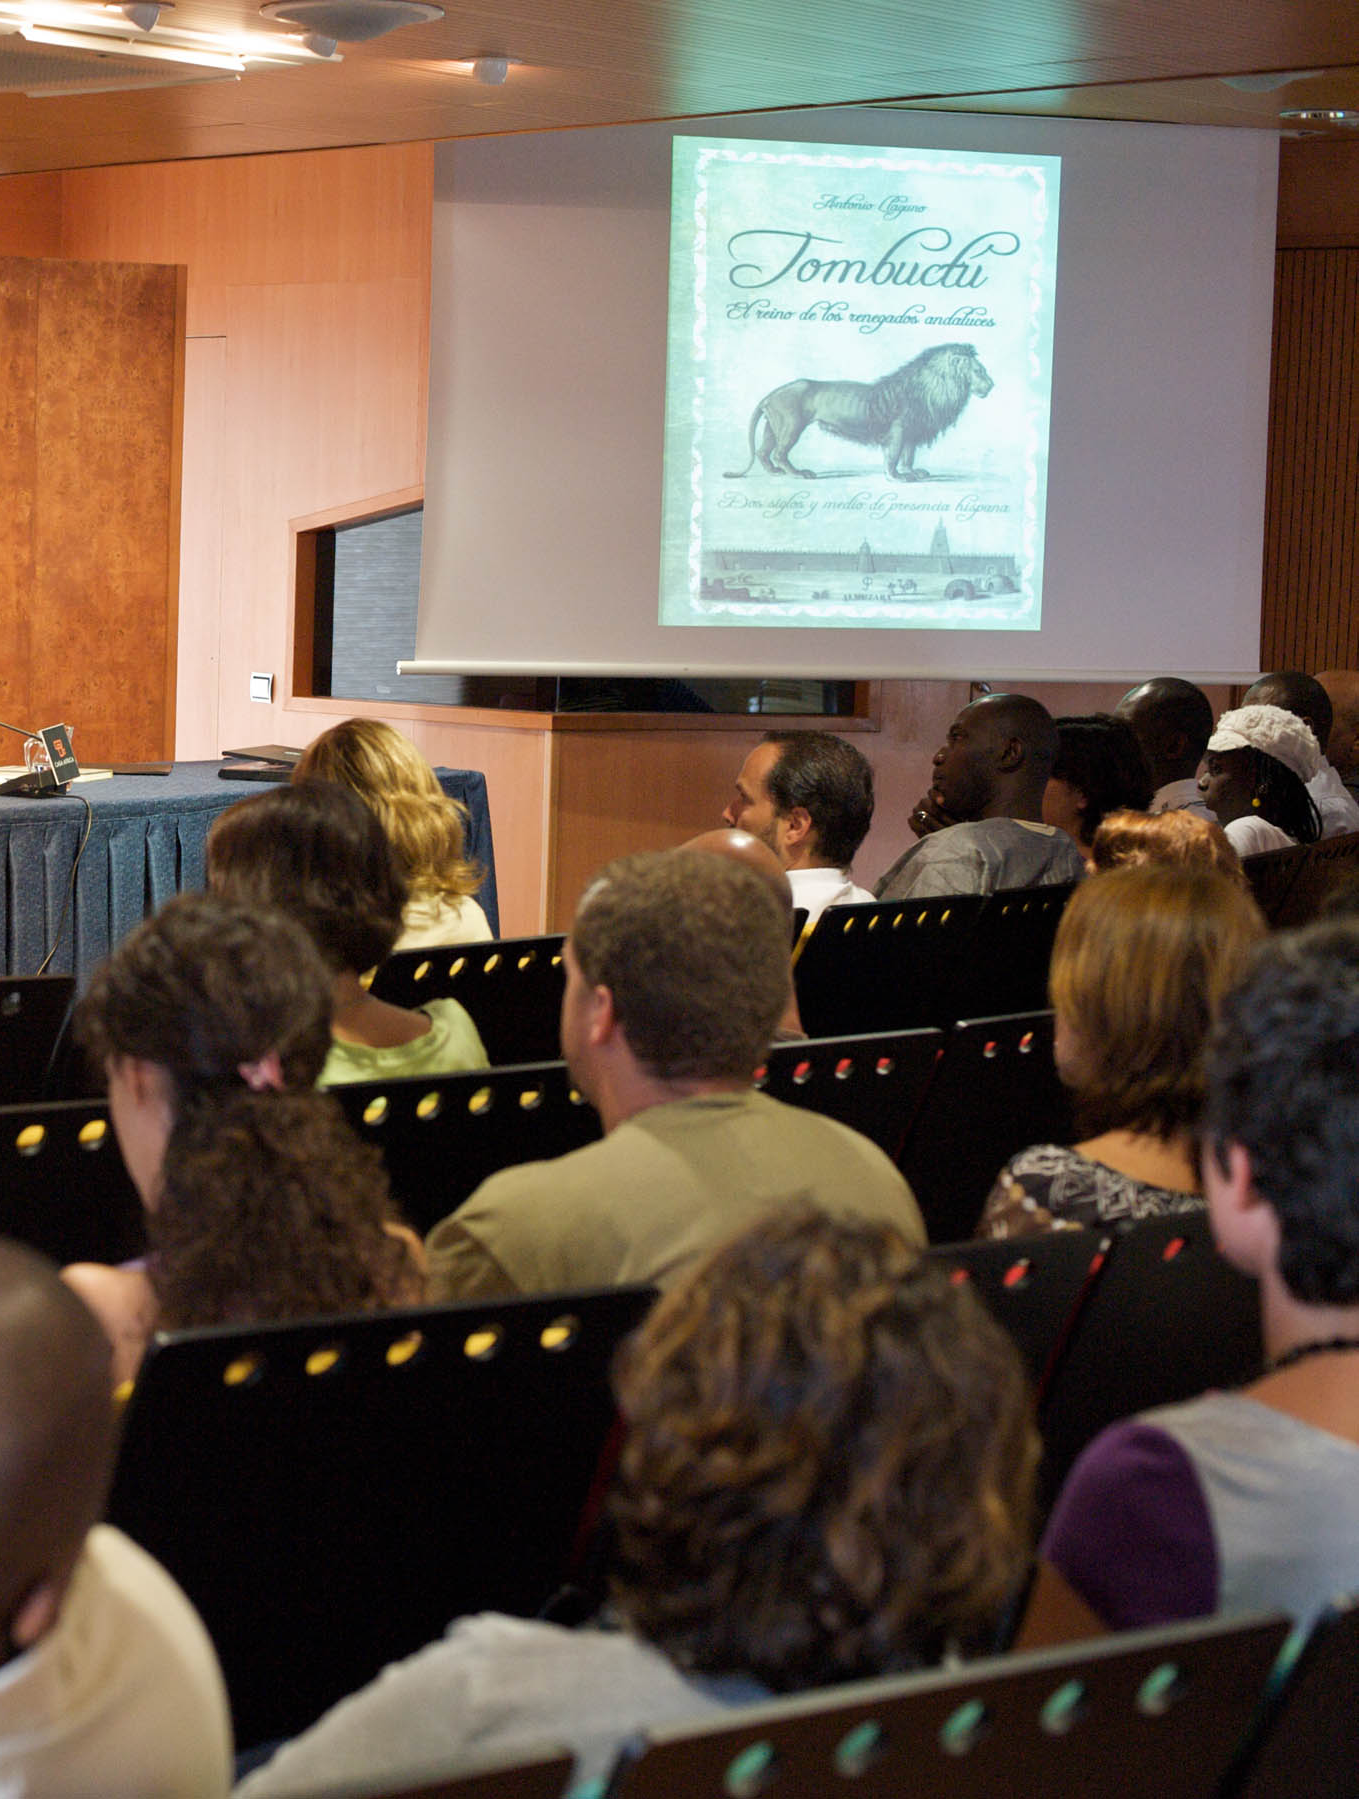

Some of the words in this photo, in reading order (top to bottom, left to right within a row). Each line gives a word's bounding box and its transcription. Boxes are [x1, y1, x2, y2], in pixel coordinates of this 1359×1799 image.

[813, 193, 874, 211] Antonio
[878, 195, 928, 221] Llaguno
[727, 226, 1021, 290] Tombuctú
[726, 299, 770, 320] El
[755, 305, 796, 321] reino
[799, 300, 832, 322] de
[822, 301, 850, 322] los
[849, 304, 926, 334] renegados
[925, 306, 997, 328] andaluces
[762, 490, 811, 520] siglos
[821, 490, 873, 511] medio
[869, 492, 899, 511] de
[869, 500, 951, 520] presencia
[955, 494, 1011, 521] hispana
